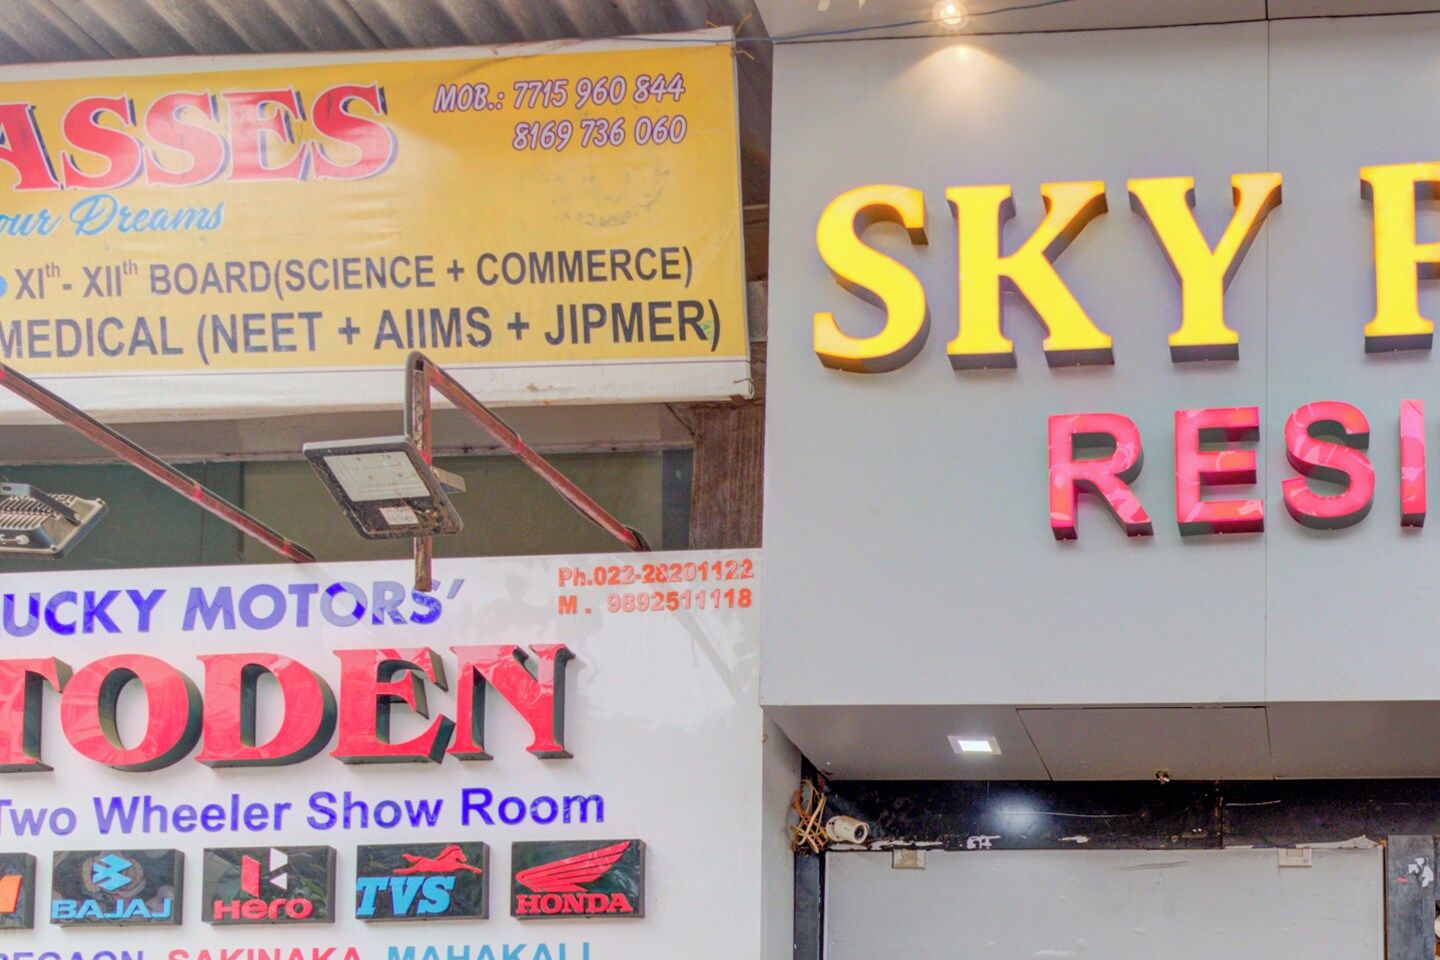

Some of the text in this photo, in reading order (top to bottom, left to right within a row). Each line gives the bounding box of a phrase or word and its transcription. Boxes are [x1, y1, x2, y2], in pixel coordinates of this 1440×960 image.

[433, 72, 685, 112] MOB.: 7715 960 844
[0, 84, 398, 191] ASSES
[512, 115, 687, 151] 8169 736 060
[69, 194, 225, 236] Dreams
[477, 247, 693, 288] COMMERCE)
[813, 172, 1283, 373] SKY
[198, 312, 322, 365] (NEET
[374, 306, 493, 349] AIIMS
[545, 299, 721, 352] JIPMER)
[3, 588, 167, 637] UCKY
[607, 588, 752, 613] 9892511118
[93, 794, 292, 834] Wheeler
[306, 791, 443, 830] Show
[461, 788, 605, 826] Room
[51, 898, 172, 920] BAJAJ
[356, 876, 455, 917] TVS
[515, 893, 632, 915] HONDA
